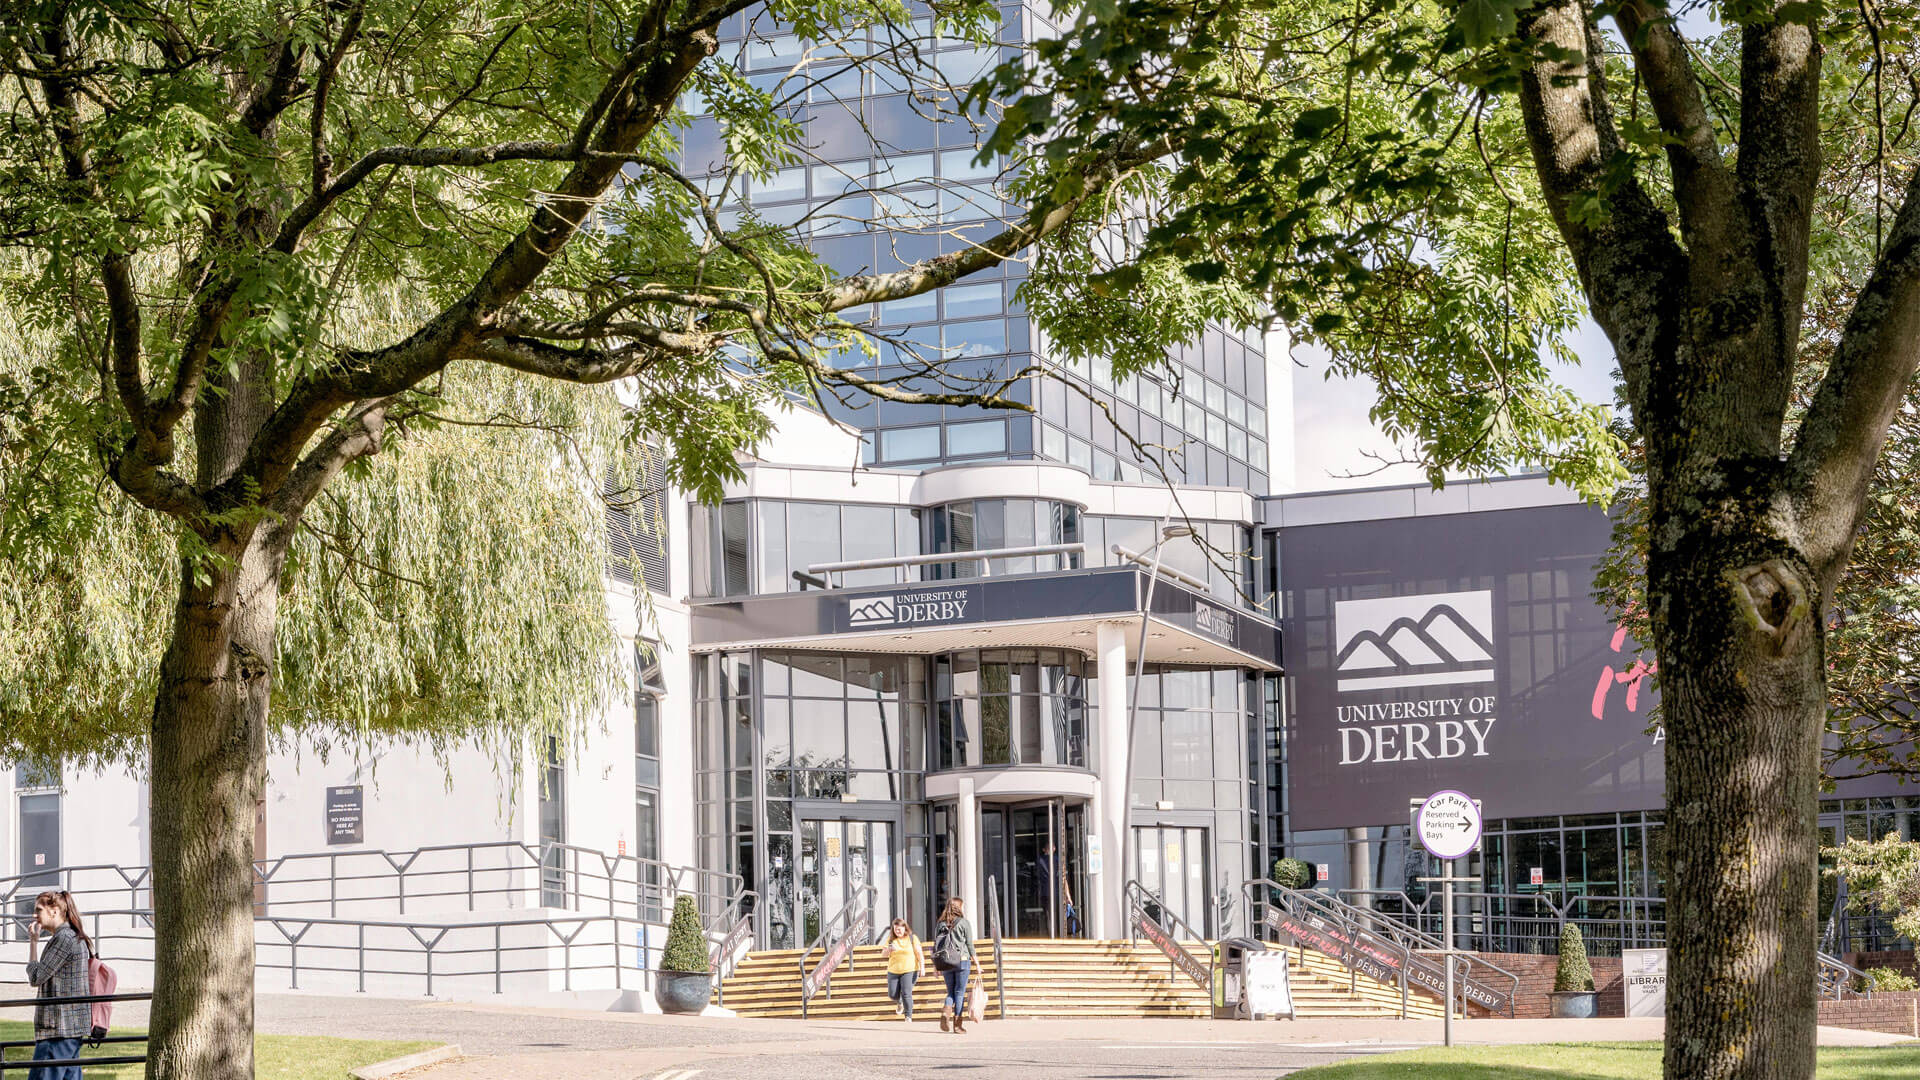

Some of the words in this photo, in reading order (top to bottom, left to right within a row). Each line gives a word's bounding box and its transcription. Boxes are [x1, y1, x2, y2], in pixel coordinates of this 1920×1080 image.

[896, 591, 953, 604] UNIVERSITY
[955, 590, 968, 600] OF
[897, 600, 968, 623] DERBY
[1211, 617, 1234, 642] DERBY
[1336, 698, 1463, 723] UNIVERSITY
[1468, 696, 1496, 714] OF
[1337, 718, 1497, 765] DERBY
[1652, 726, 1666, 745] A
[1430, 798, 1446, 809] Car
[1448, 796, 1469, 811] Park
[1426, 821, 1455, 829] Parking
[1426, 832, 1443, 840] Bays
[1281, 921, 1309, 941] MAKE
[1307, 934, 1321, 944] IT
[1319, 940, 1343, 957] REAL
[1342, 951, 1355, 963] AT
[1355, 958, 1386, 979] DERBY
[1186, 962, 1206, 983] DERBY
[1417, 971, 1445, 992] DERB
[1630, 976, 1665, 985] LIBRAR
[1464, 984, 1500, 1007] DERBY
